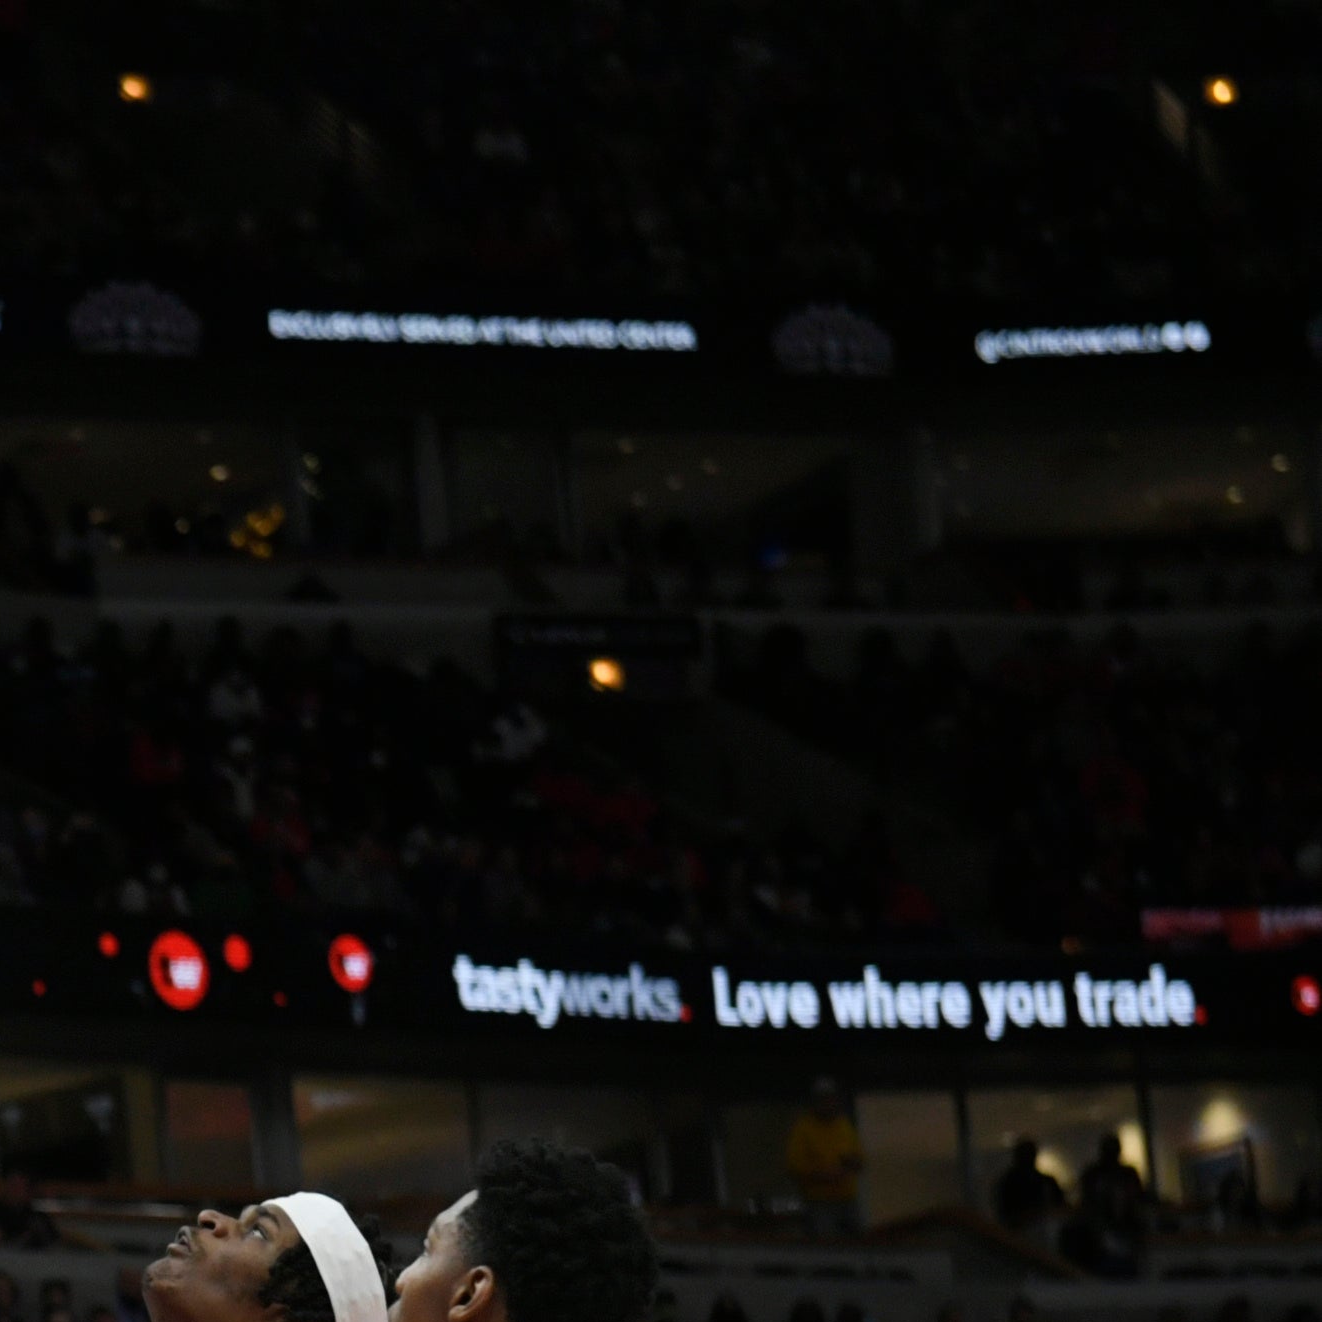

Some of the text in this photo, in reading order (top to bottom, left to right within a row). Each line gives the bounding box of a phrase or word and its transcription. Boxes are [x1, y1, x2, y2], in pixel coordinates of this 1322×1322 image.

[711, 965, 821, 1028] Love
[828, 964, 972, 1029] where
[979, 980, 1067, 1041] you
[1074, 963, 1207, 1028] trade.
